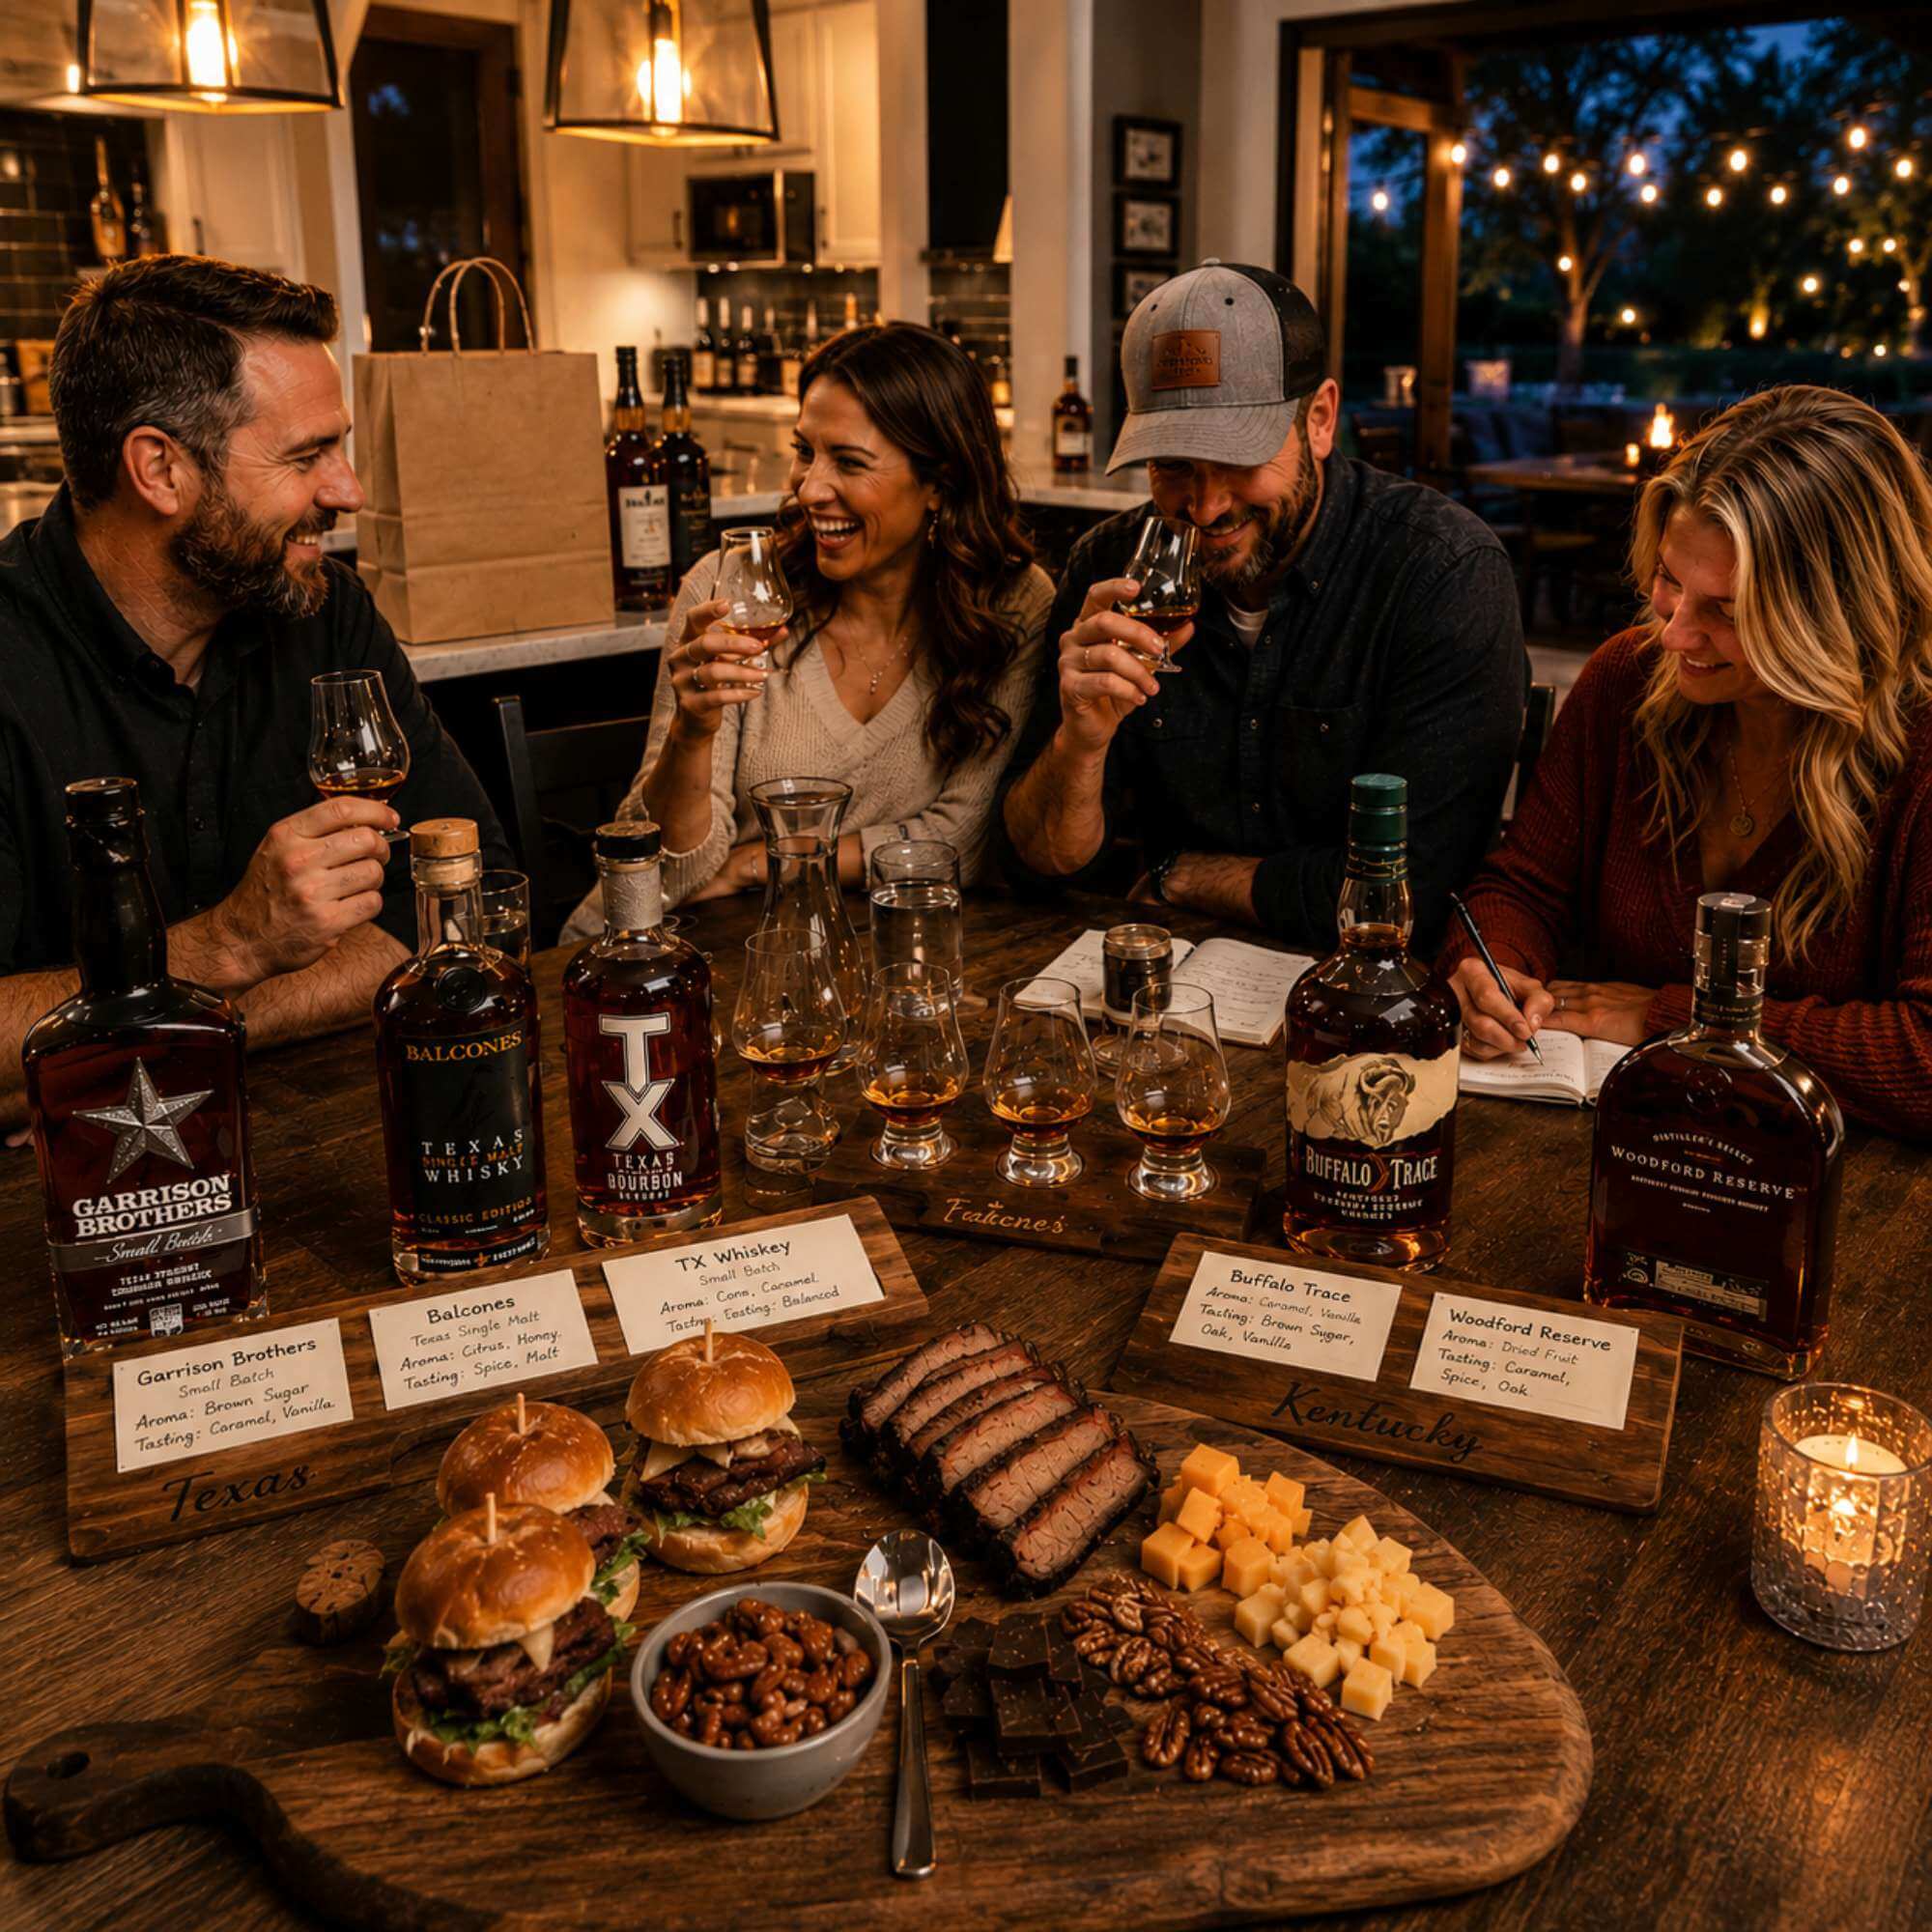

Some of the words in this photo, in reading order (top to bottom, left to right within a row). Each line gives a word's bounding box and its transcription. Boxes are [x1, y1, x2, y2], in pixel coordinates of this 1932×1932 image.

[406, 1030, 523, 1062] BALCONES
[421, 1128, 523, 1156] TEXAS
[425, 1155, 523, 1183] WHISKY
[612, 1151, 675, 1170] TEXAS
[1306, 1145, 1372, 1186] BUFFALO
[1389, 1155, 1438, 1190] TRACE
[1610, 1145, 1705, 1179] WOODFORD
[1713, 1171, 1796, 1200] RESERVE
[72, 1174, 231, 1218] GARRISON
[608, 1171, 684, 1191] BOURBON
[75, 1193, 232, 1237] BROTHERS
[675, 1255, 707, 1272] TX
[713, 1240, 790, 1265] Whiskey
[699, 1268, 737, 1287] Small
[1231, 1268, 1294, 1293] Buffalo
[1304, 1282, 1351, 1303] Trace
[427, 1296, 516, 1324] Balcones
[660, 1296, 710, 1316] Aroma:
[1206, 1287, 1255, 1304] Aroma:
[458, 1320, 501, 1342] Single
[508, 1311, 540, 1326] Malt
[1261, 1314, 1303, 1334] Brown
[1449, 1308, 1532, 1336] Woodford
[1540, 1325, 1611, 1351] Reserve
[1442, 1329, 1493, 1350] Aroma:
[1501, 1341, 1540, 1357] Dried
[137, 1358, 224, 1387] Garrison
[232, 1339, 317, 1367] Brothers
[400, 1351, 455, 1372] Aroma:
[404, 1371, 465, 1391] Tasting:
[526, 1347, 559, 1364] Malt
[1504, 1360, 1570, 1386] Caramel,
[179, 1378, 221, 1399] Small
[230, 1368, 275, 1387] Batch
[1498, 1380, 1529, 1397] Oak
[135, 1408, 195, 1431] Aroma:
[204, 1397, 254, 1416] Brown
[264, 1383, 309, 1405] Sugar
[1271, 1380, 1484, 1464] Kentucky
[134, 1430, 202, 1452] Tasting:
[162, 1463, 314, 1522] Texas
